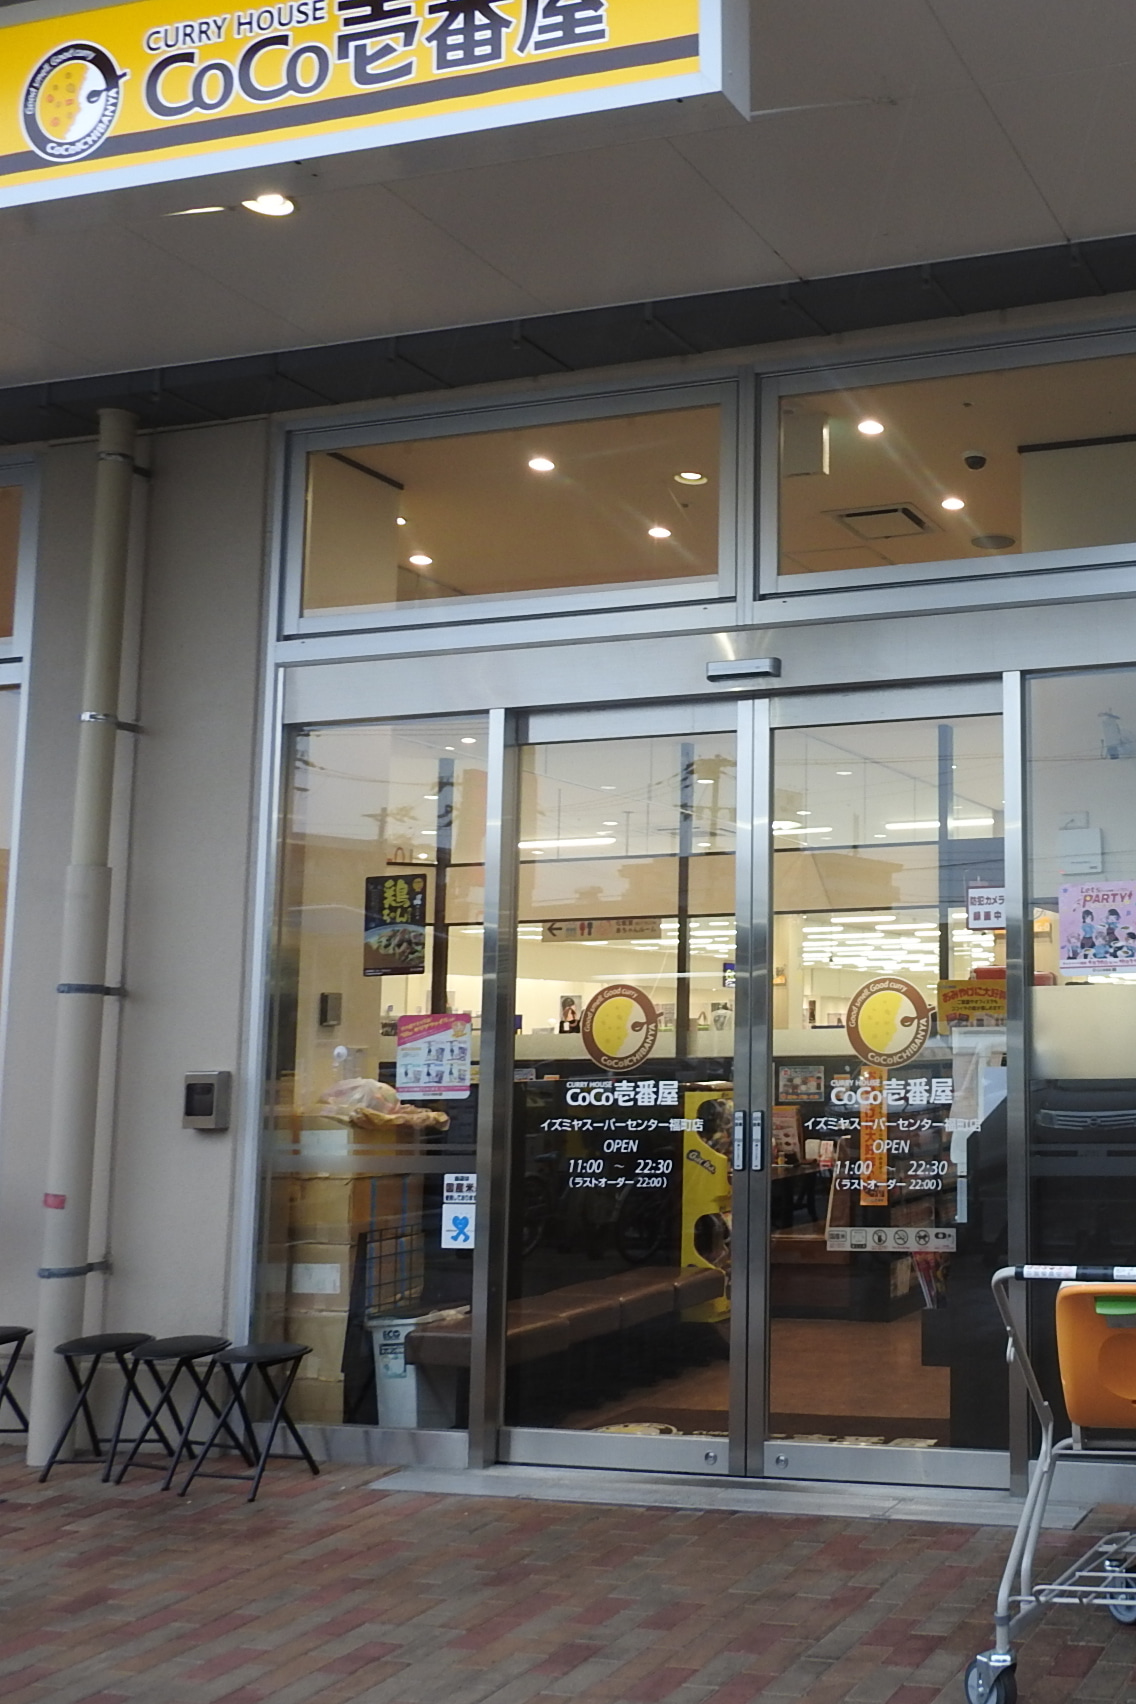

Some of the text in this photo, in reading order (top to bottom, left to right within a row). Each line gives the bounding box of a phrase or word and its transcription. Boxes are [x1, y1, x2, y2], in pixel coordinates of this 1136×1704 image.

[146, 0, 326, 52] CURRY HOUSE
[869, 980, 889, 992] Good
[600, 1022, 656, 1067] CoCoICHIBANYA
[867, 1018, 928, 1064] CoCoICHIBANYA
[830, 1079, 854, 1087] CURRY
[566, 1080, 679, 1106] CoCo壱番屋
[830, 1077, 953, 1105] CoCo壱番屋
[603, 1139, 638, 1153] OPEN
[872, 1140, 910, 1154] OPEN
[569, 1159, 604, 1173] 11:00
[635, 1159, 673, 1174] 22:30
[835, 1161, 873, 1175] 11:00
[907, 1161, 948, 1175] 22:30
